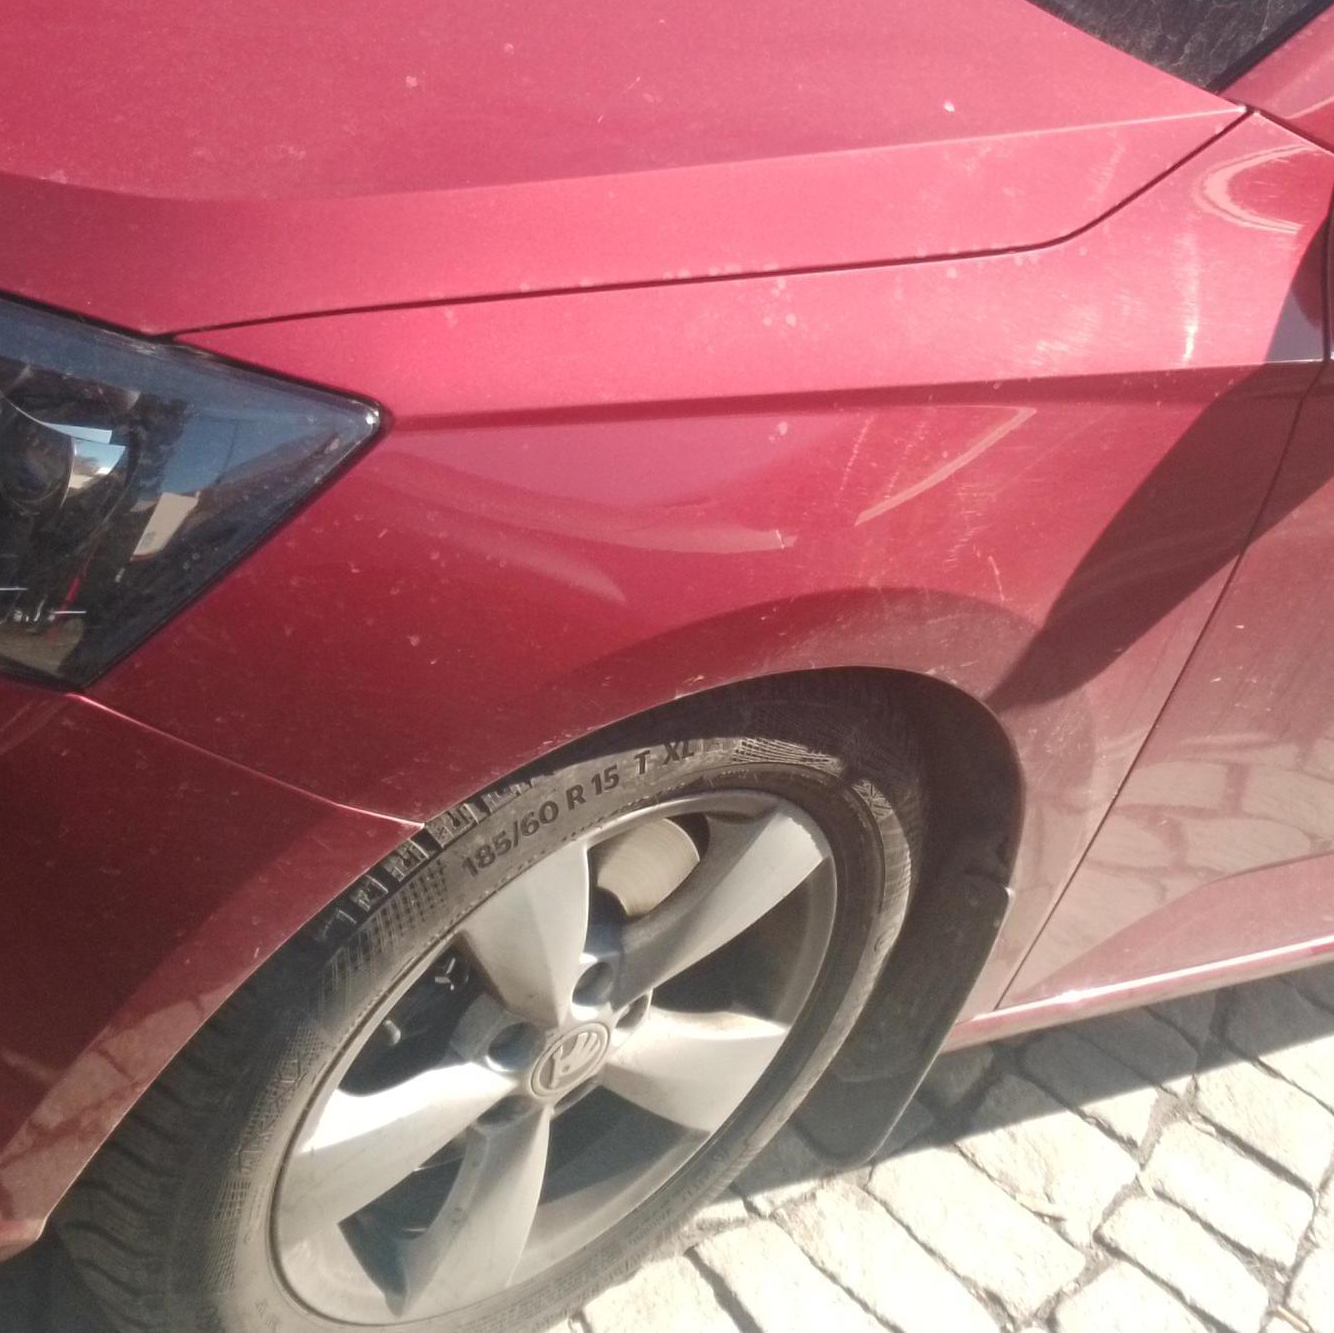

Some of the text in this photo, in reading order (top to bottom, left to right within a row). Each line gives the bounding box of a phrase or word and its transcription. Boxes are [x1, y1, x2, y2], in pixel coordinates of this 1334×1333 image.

[461, 739, 695, 877] 185/60 R 15 T XL
